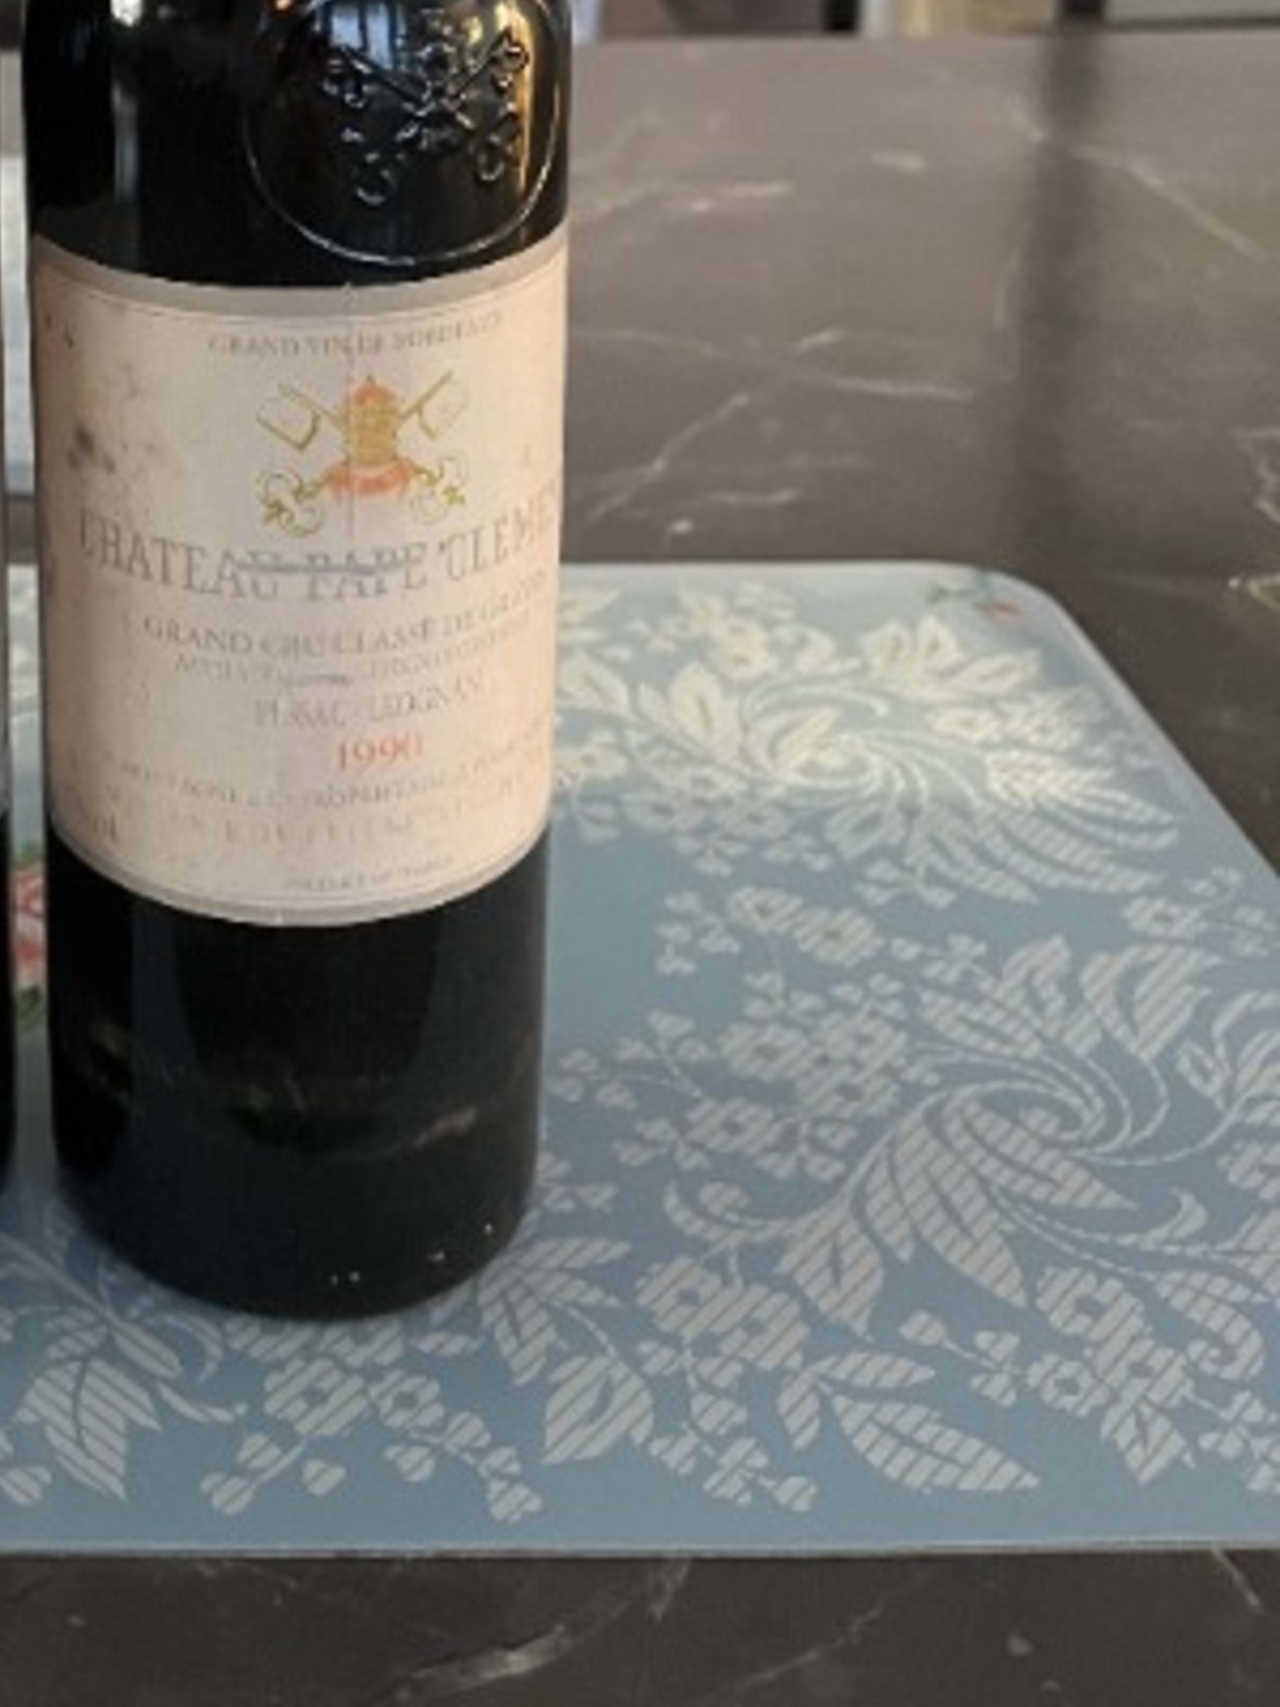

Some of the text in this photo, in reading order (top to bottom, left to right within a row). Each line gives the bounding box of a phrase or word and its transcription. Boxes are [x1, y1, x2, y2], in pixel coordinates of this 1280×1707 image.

[78, 507, 280, 601] CHATEAU
[305, 541, 427, 601] PAPE
[336, 730, 424, 771] 1990
